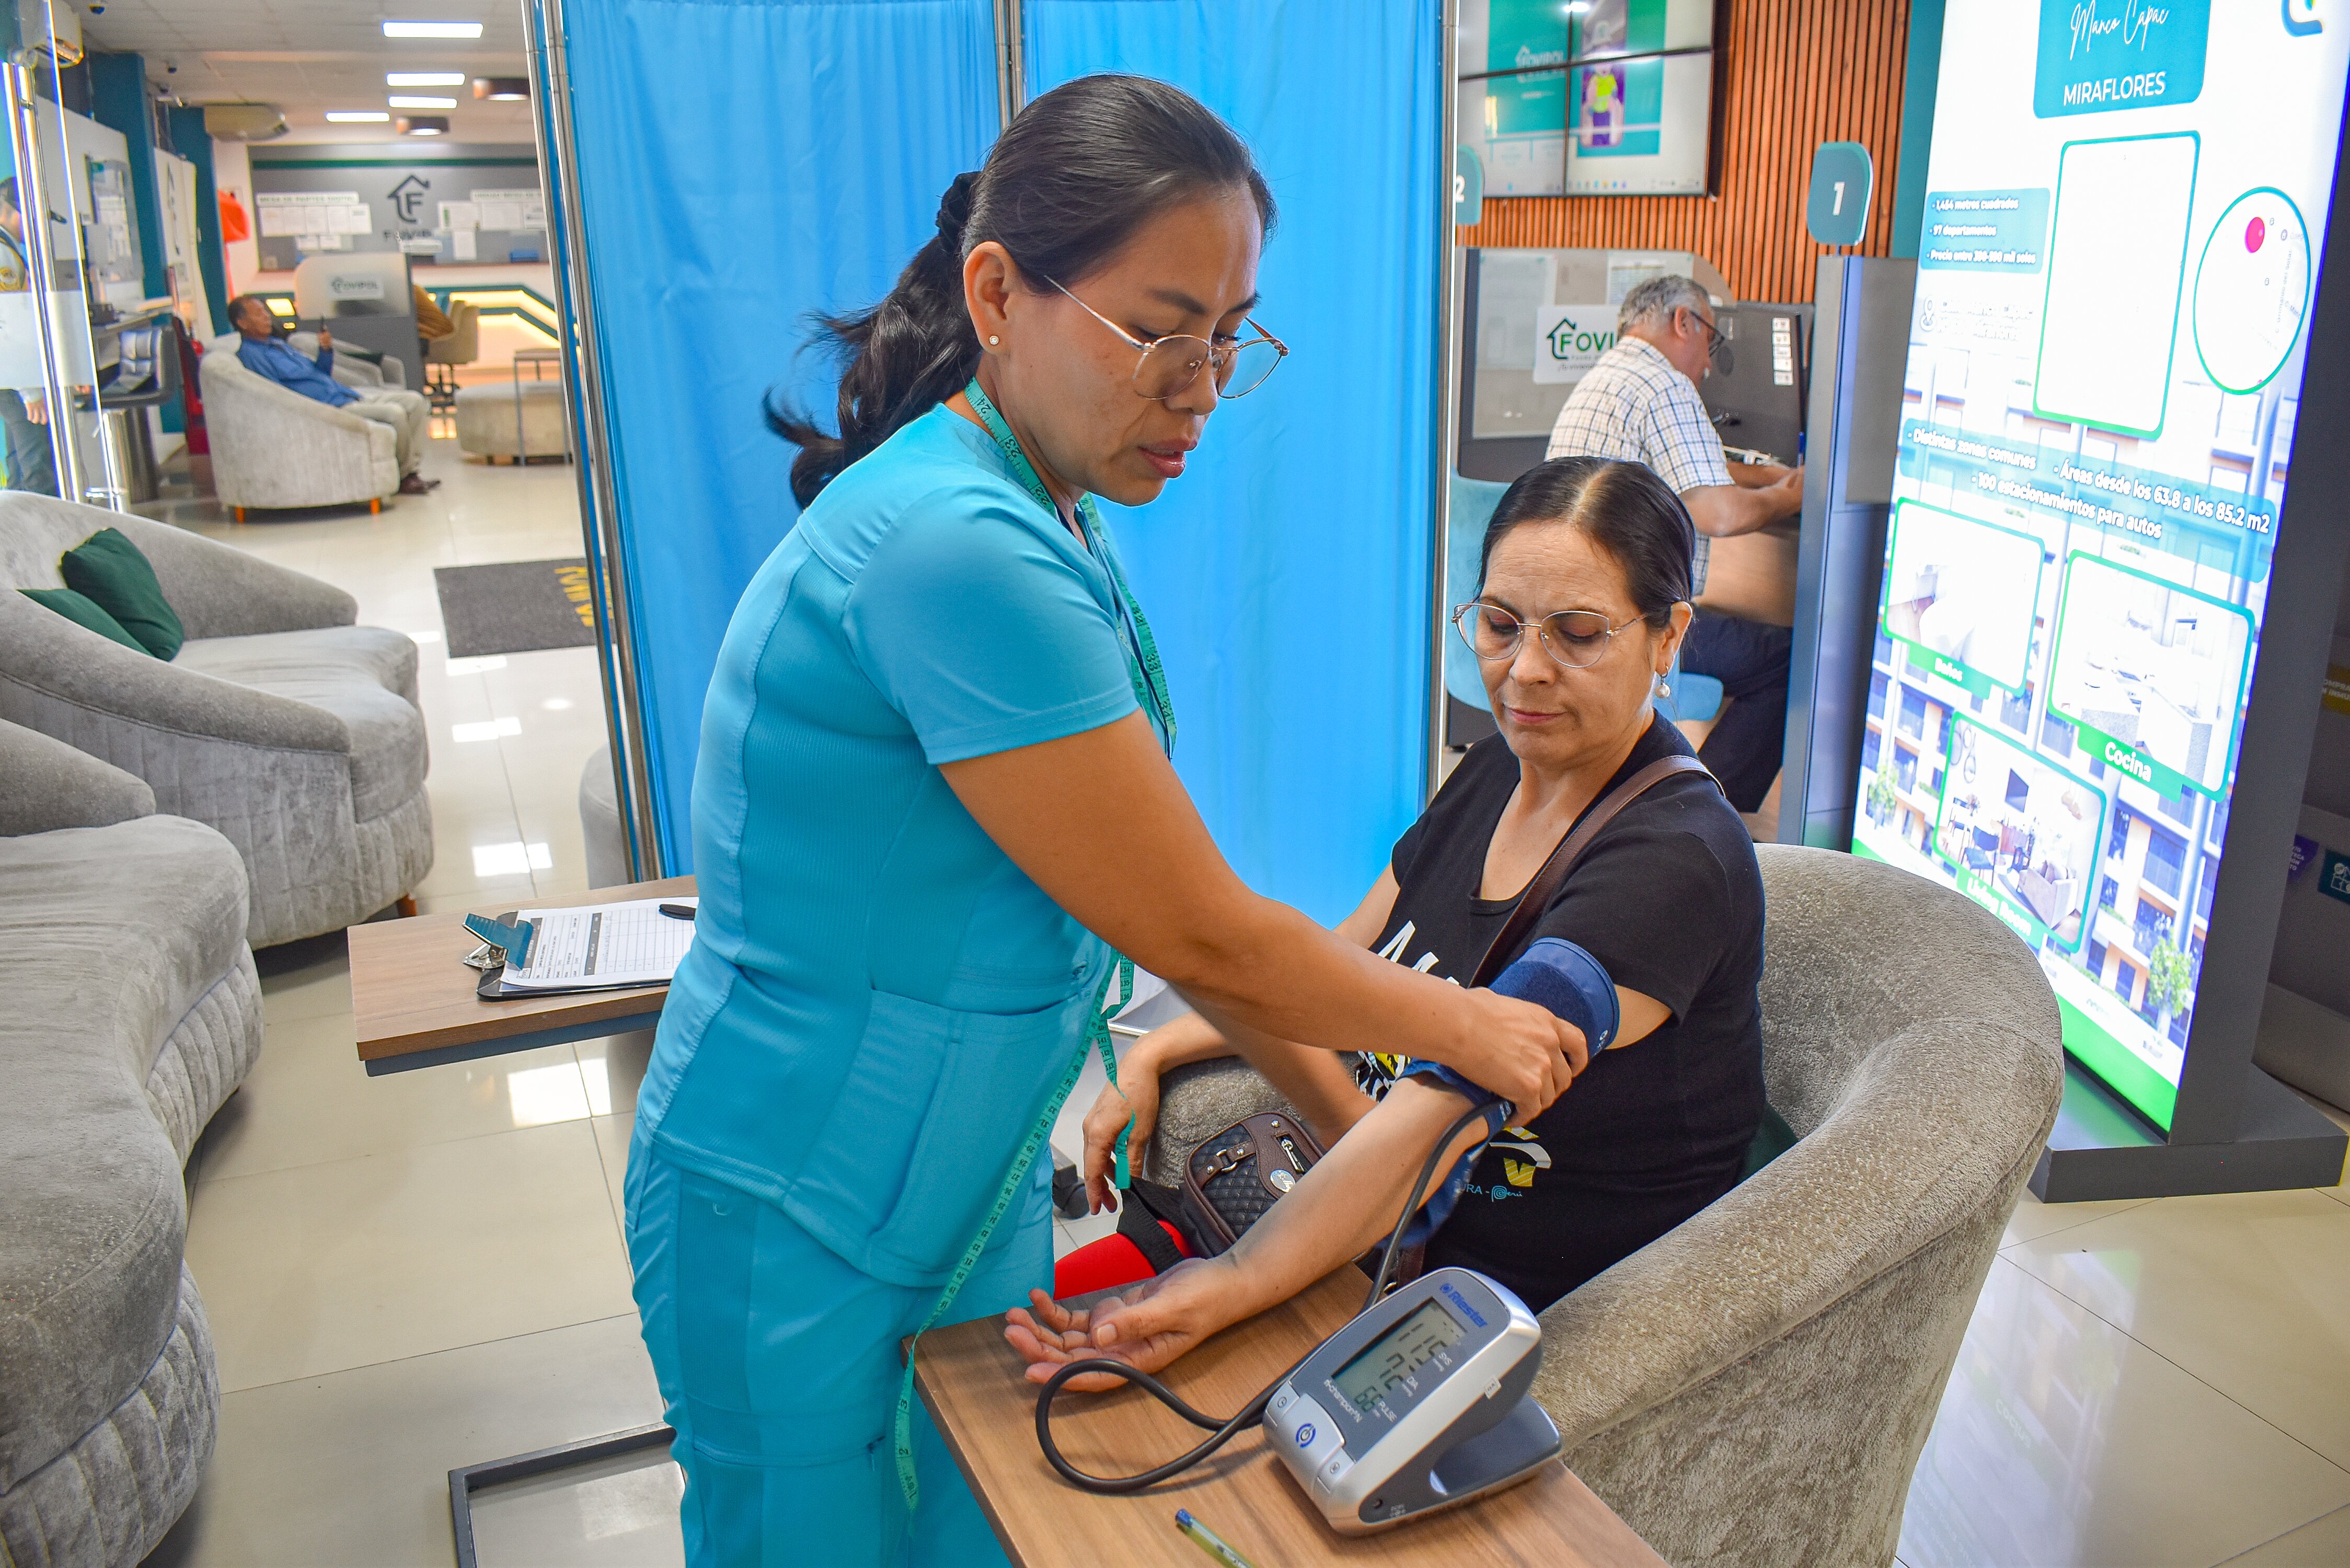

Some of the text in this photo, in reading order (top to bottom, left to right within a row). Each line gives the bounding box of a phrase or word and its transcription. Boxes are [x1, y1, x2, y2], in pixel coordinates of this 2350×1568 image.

[2070, 0, 2169, 61] Manco Capac
[2064, 71, 2167, 106] MIRAFLORES
[1456, 175, 1465, 203] 2
[1833, 181, 1845, 216] 1
[1954, 200, 1980, 210] metros
[1980, 197, 2019, 209] cuadrados
[1933, 224, 1997, 238] 97 departamentos
[1930, 248, 1953, 261] Precio
[1953, 251, 1974, 262] entre
[2003, 250, 2016, 263] mil
[2016, 251, 2036, 264] soles
[1560, 331, 1615, 352] FOVI
[976, 397, 992, 414] 24
[1005, 438, 1022, 458] 23
[1913, 428, 2036, 470] Distintas zonas comunes
[1035, 486, 1051, 505] 22
[1978, 471, 2162, 539] 100 estacionamientos para autos
[2059, 458, 2271, 534] Áreas desde los 63.8 a los 85.2 m2
[2105, 741, 2152, 782] Cocina
[1966, 877, 2032, 937] Living Room
[1056, 1092, 1065, 1101] 33
[1048, 1106, 1057, 1114] 32
[1040, 1119, 1050, 1128] 31
[1033, 1132, 1042, 1140] 30
[1011, 1173, 1021, 1181] 27
[1491, 1185, 1523, 1202] Perú
[965, 1258, 973, 1266] 21
[1448, 1290, 1489, 1328] Riester
[1438, 1352, 1453, 1366] SYS
[900, 1399, 908, 1410] 3
[1378, 1400, 1398, 1423] PULSE
